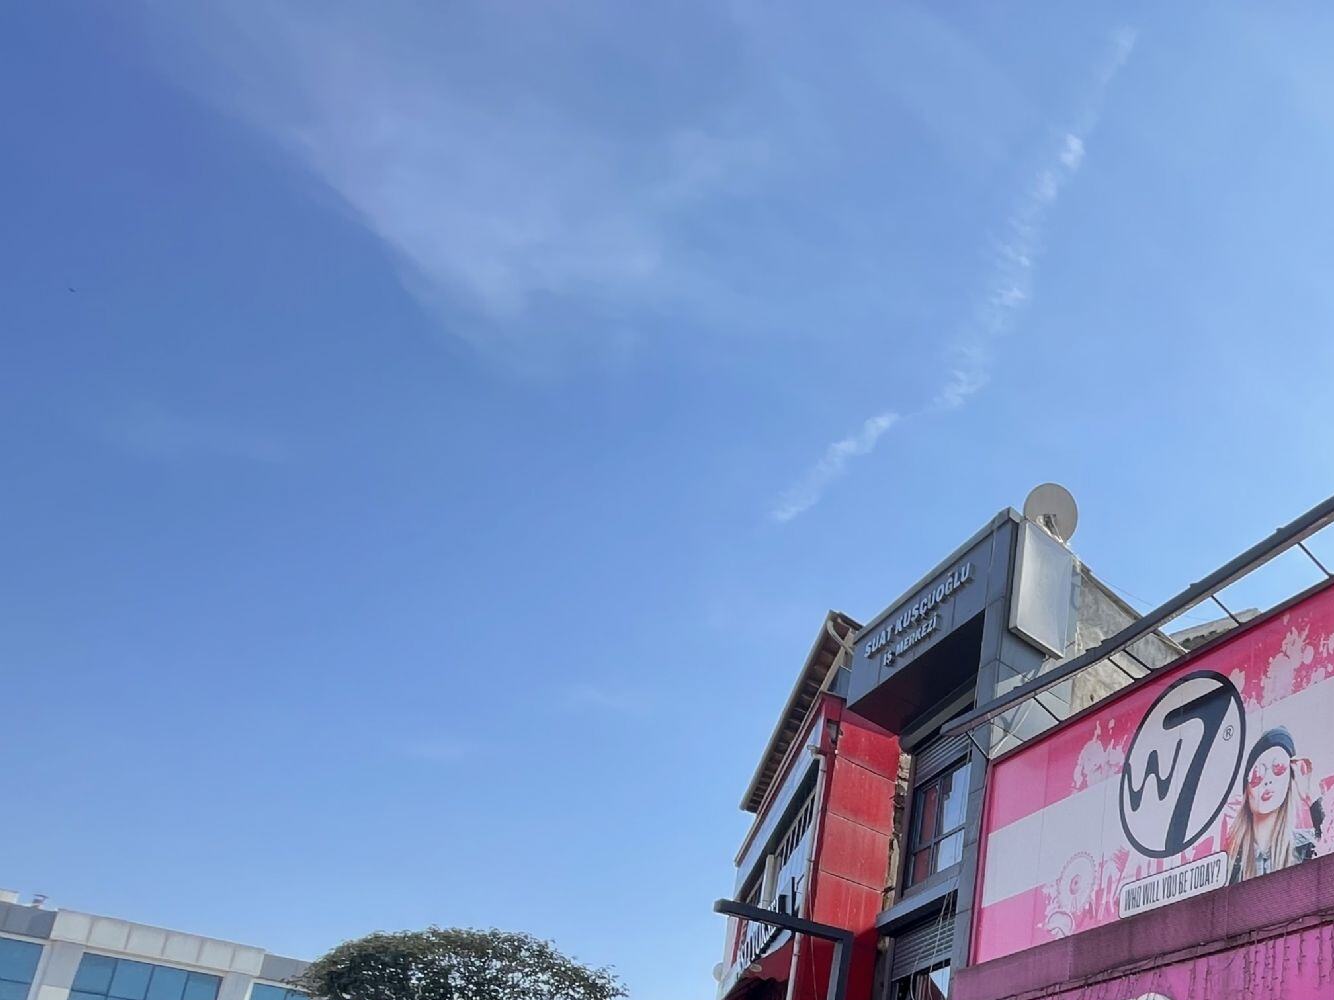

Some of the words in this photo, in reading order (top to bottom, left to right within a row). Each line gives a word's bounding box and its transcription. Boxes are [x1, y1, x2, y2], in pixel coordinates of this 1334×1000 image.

[863, 624, 894, 658] SUAT
[1124, 884, 1141, 911] WHO
[1142, 879, 1159, 905] WILL
[1162, 872, 1177, 899] YOU
[1178, 869, 1189, 895] BE
[1189, 859, 1221, 892] TODAY?
